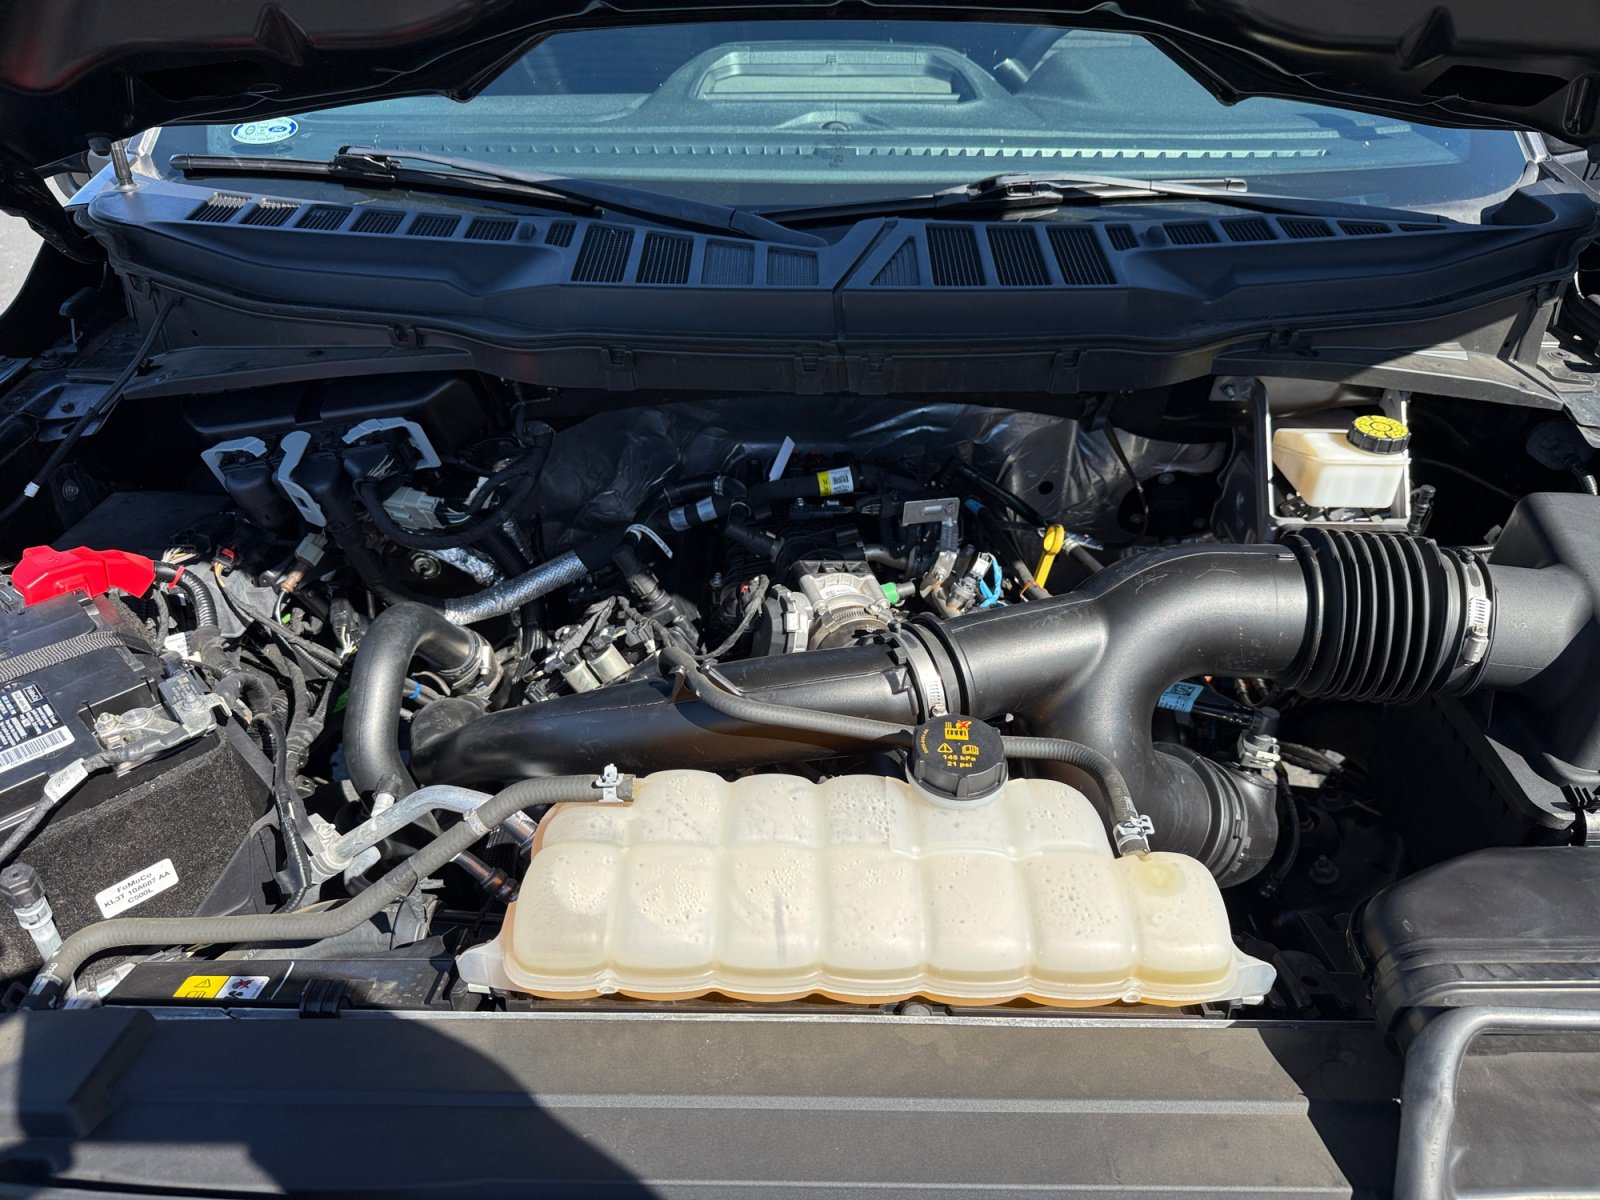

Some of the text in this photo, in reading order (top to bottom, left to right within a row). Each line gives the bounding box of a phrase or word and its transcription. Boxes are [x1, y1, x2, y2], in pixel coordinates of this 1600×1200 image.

[104, 894, 126, 908] KL3T
[158, 871, 171, 881] AA
[117, 872, 152, 893] FoMoCo
[127, 887, 154, 904] C500L
